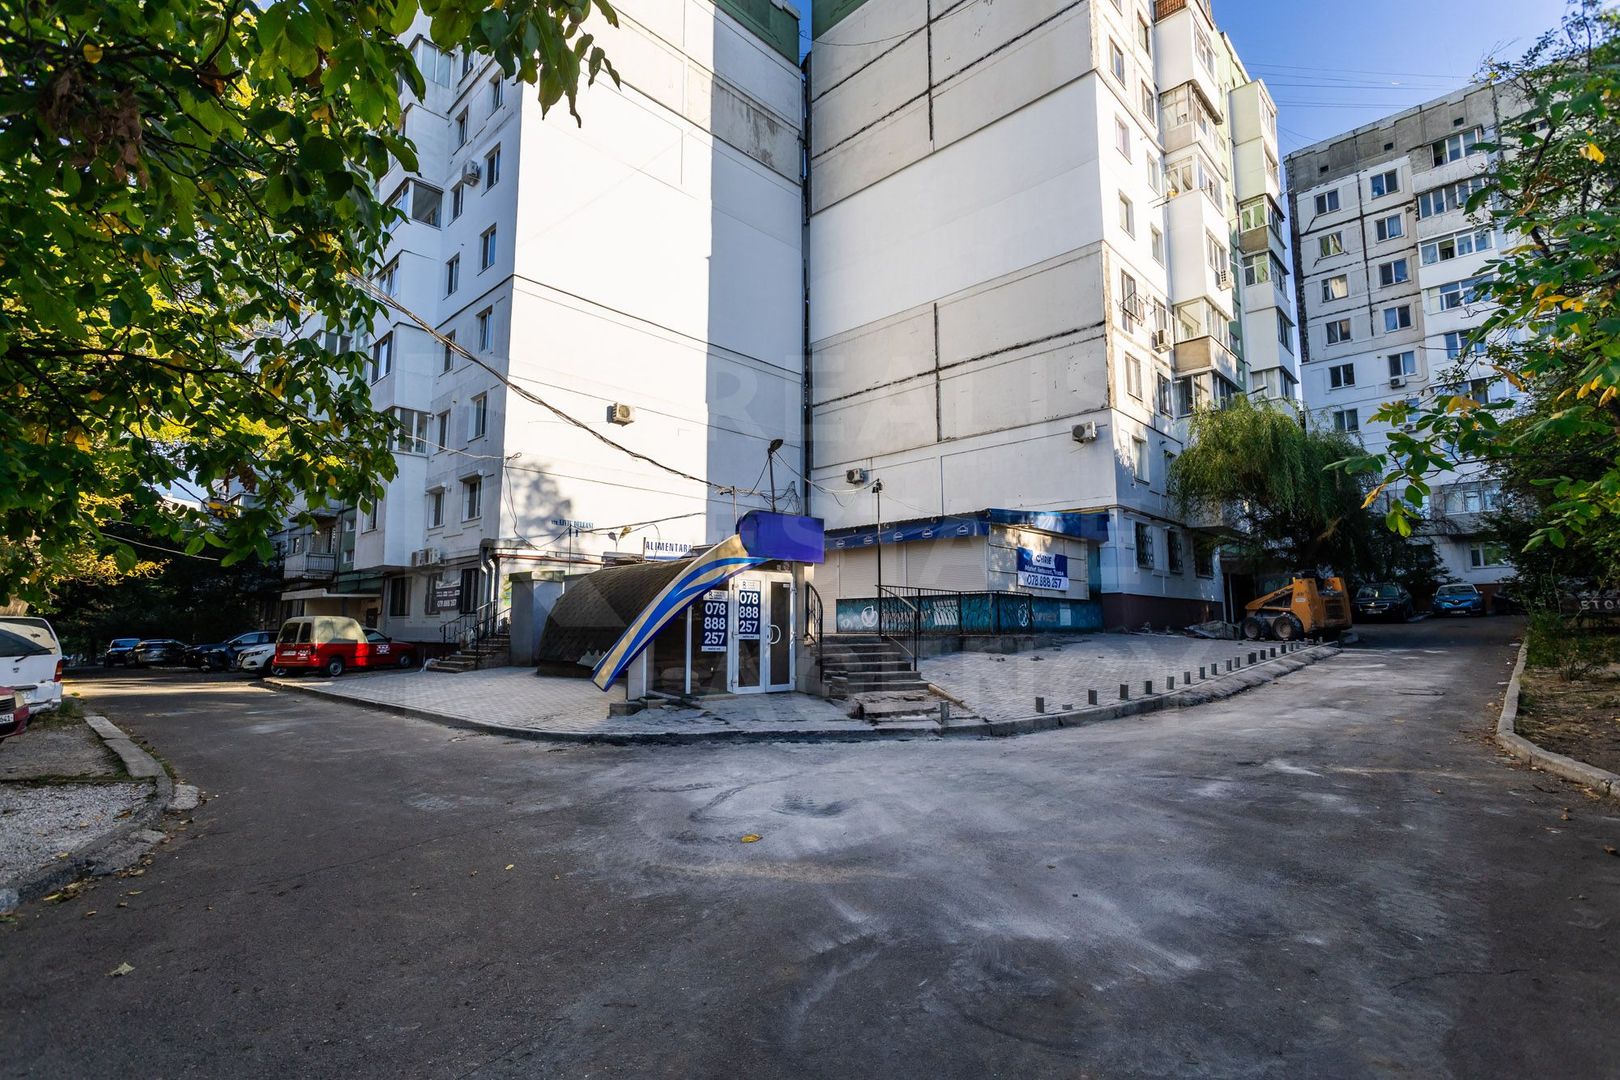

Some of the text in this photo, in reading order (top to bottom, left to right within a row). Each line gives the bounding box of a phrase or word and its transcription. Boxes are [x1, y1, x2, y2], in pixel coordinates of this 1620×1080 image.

[740, 592, 759, 604] 078
[705, 602, 726, 615] 078
[739, 606, 759, 618] 888
[704, 617, 726, 630] 888
[739, 620, 758, 633] 257
[704, 632, 725, 644] 257
